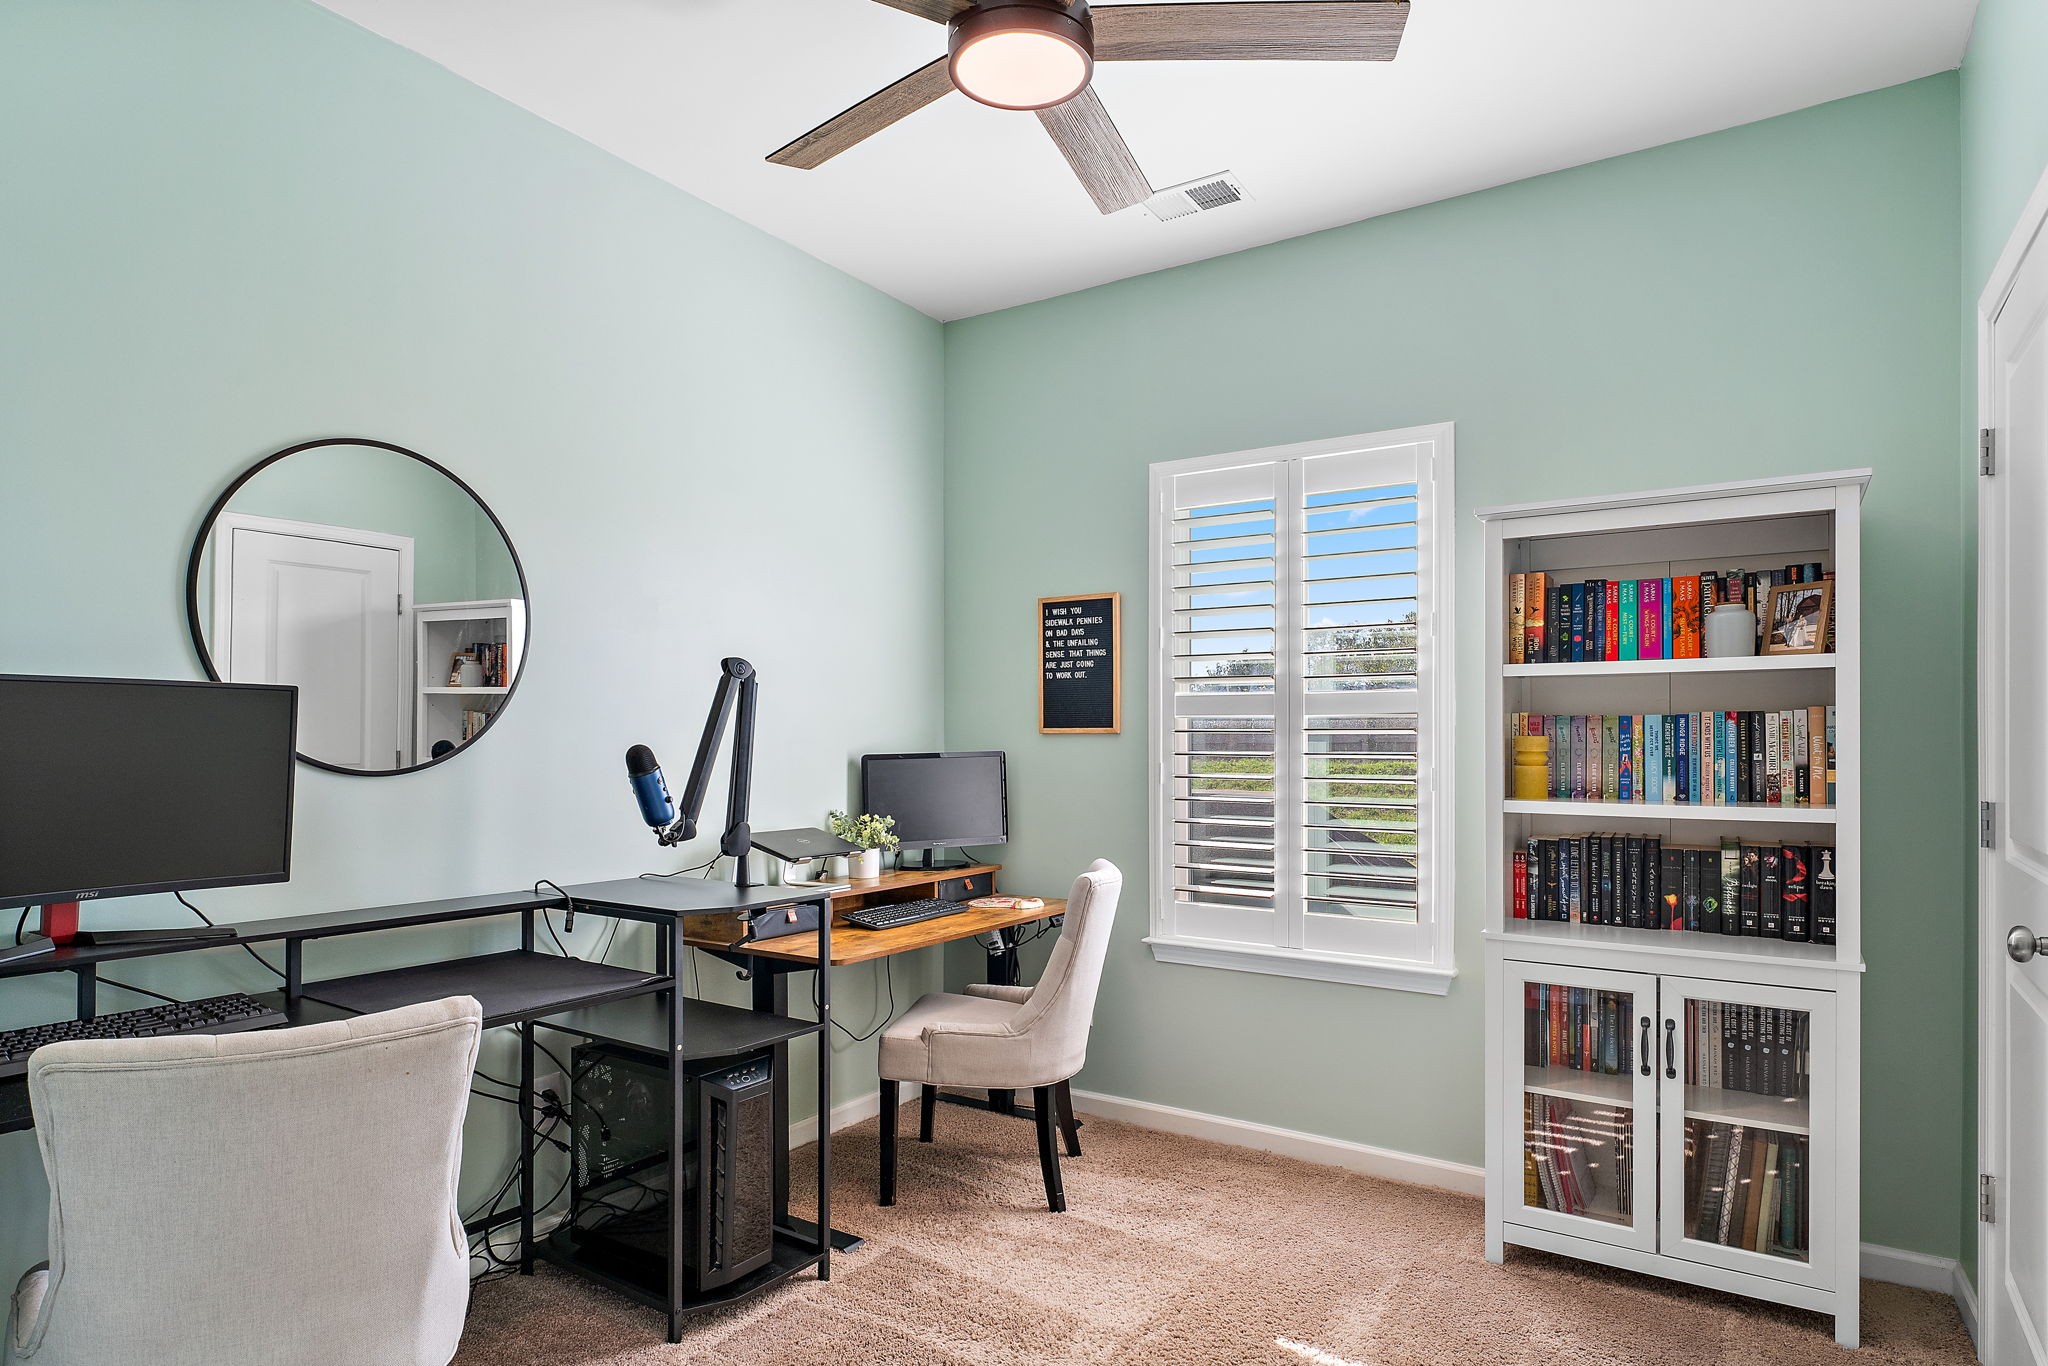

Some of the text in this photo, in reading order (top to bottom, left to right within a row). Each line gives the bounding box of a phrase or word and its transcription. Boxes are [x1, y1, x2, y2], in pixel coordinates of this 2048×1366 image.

[1767, 723, 1776, 741] JAMIE
[1812, 736, 1824, 755] Wait
[1571, 847, 1579, 858] LOVE
[1571, 860, 1579, 879] LETTERS
